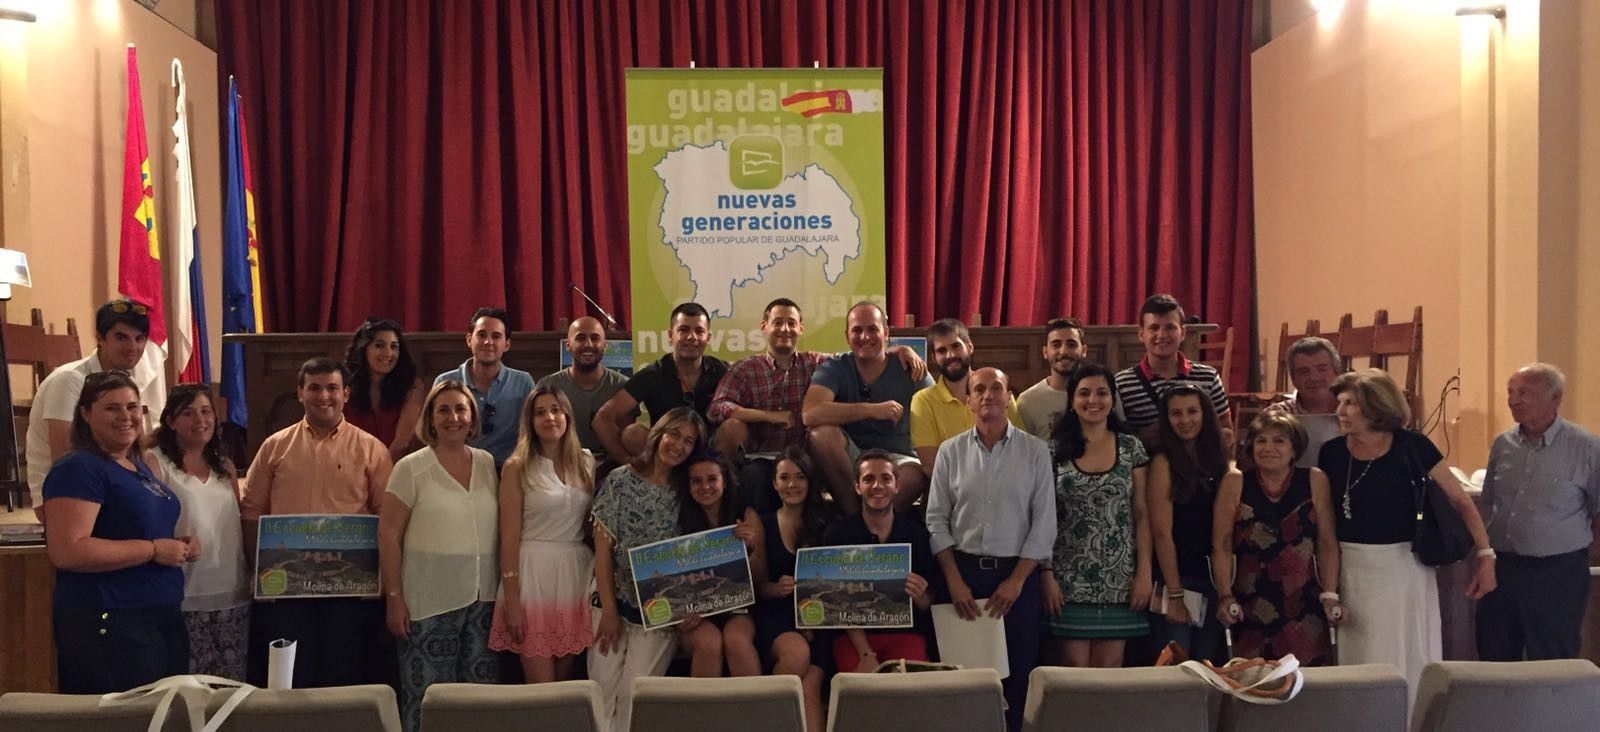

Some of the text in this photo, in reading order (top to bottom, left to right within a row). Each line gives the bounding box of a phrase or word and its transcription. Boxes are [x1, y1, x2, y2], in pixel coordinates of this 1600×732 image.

[717, 193, 797, 209] nuevas
[681, 211, 833, 236] generaciones
[676, 234, 840, 245] PARTIDO POPULAR DE GUADALAJARA
[638, 328, 767, 353] nuvas
[870, 549, 905, 564] Verano
[303, 579, 377, 592] Molina de Aragón
[686, 601, 713, 615] Molina
[714, 597, 723, 608] de
[839, 610, 910, 625] Molina de Aragón
